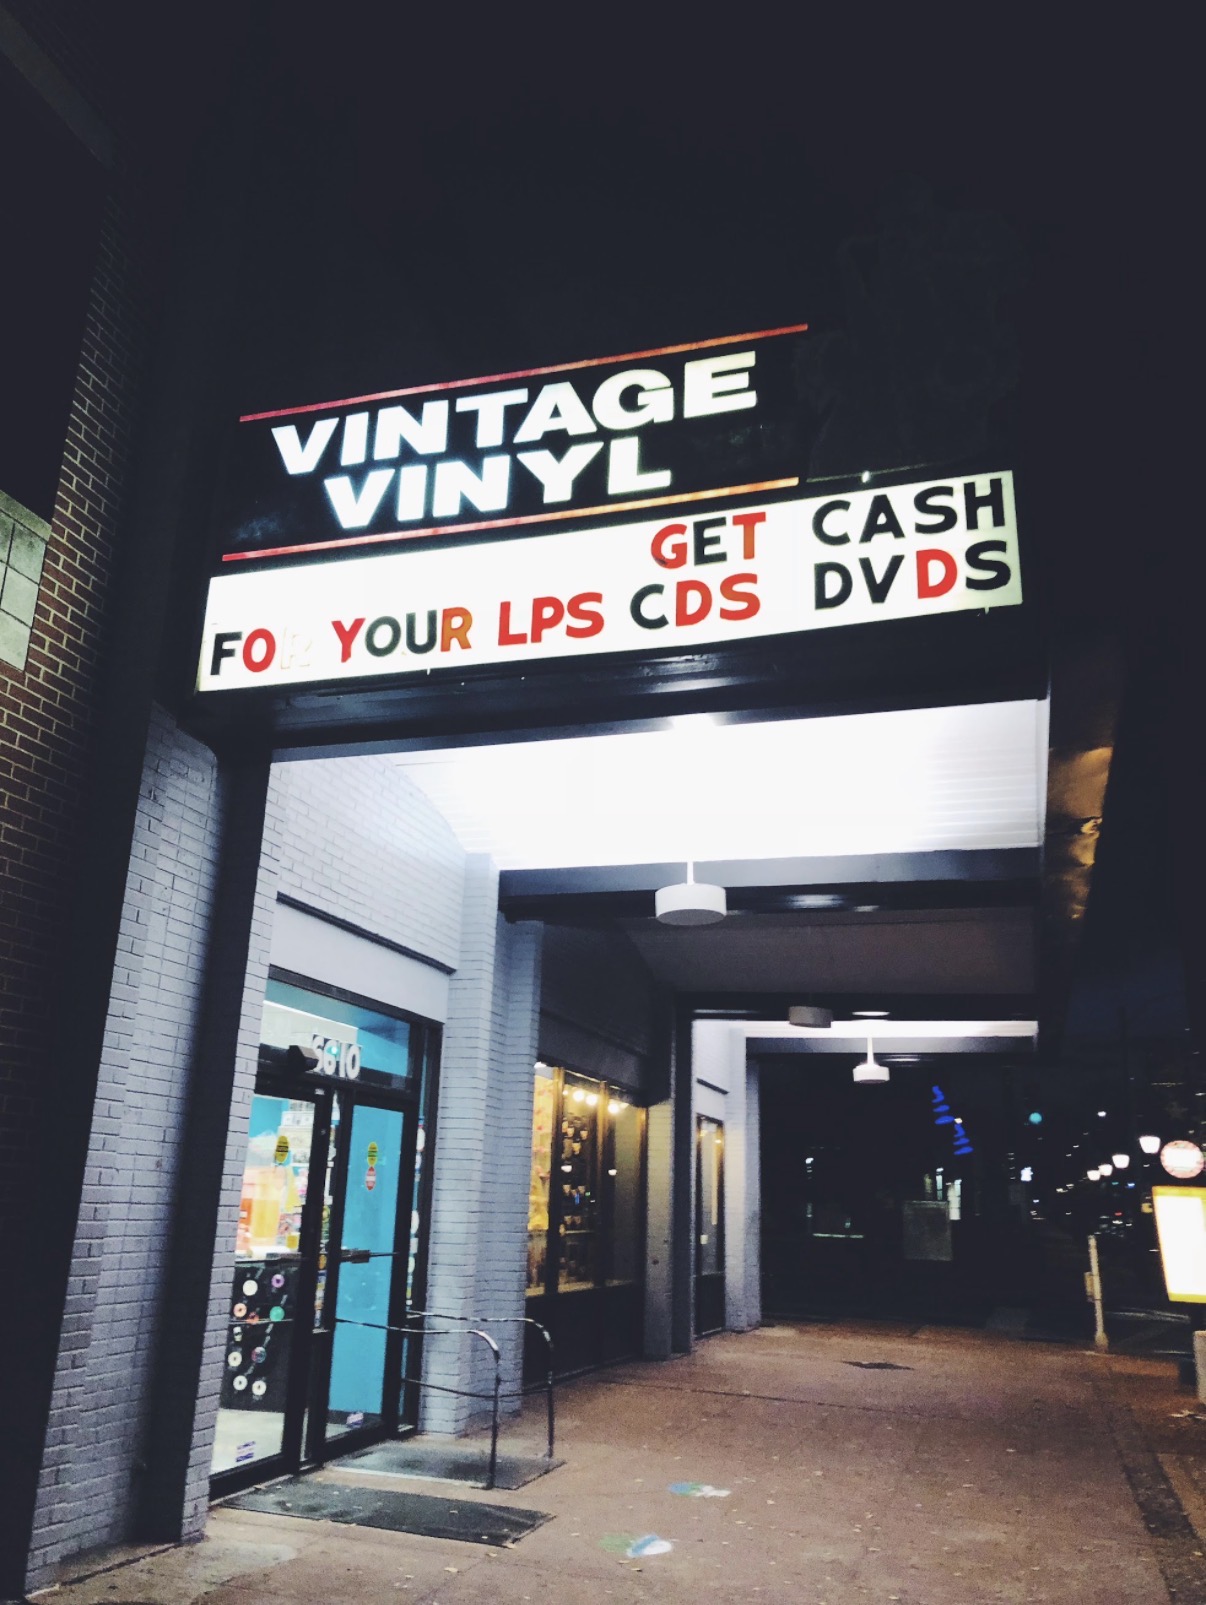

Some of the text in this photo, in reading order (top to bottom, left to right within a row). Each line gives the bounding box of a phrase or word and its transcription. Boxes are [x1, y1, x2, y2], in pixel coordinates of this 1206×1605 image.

[271, 351, 758, 476] VINTAGE
[324, 436, 672, 531] VINYL
[651, 478, 1006, 570] GET CASH
[331, 606, 472, 663] YOUR
[498, 592, 605, 647] LPS
[630, 573, 760, 630] CDS
[814, 539, 1012, 611] DVDS
